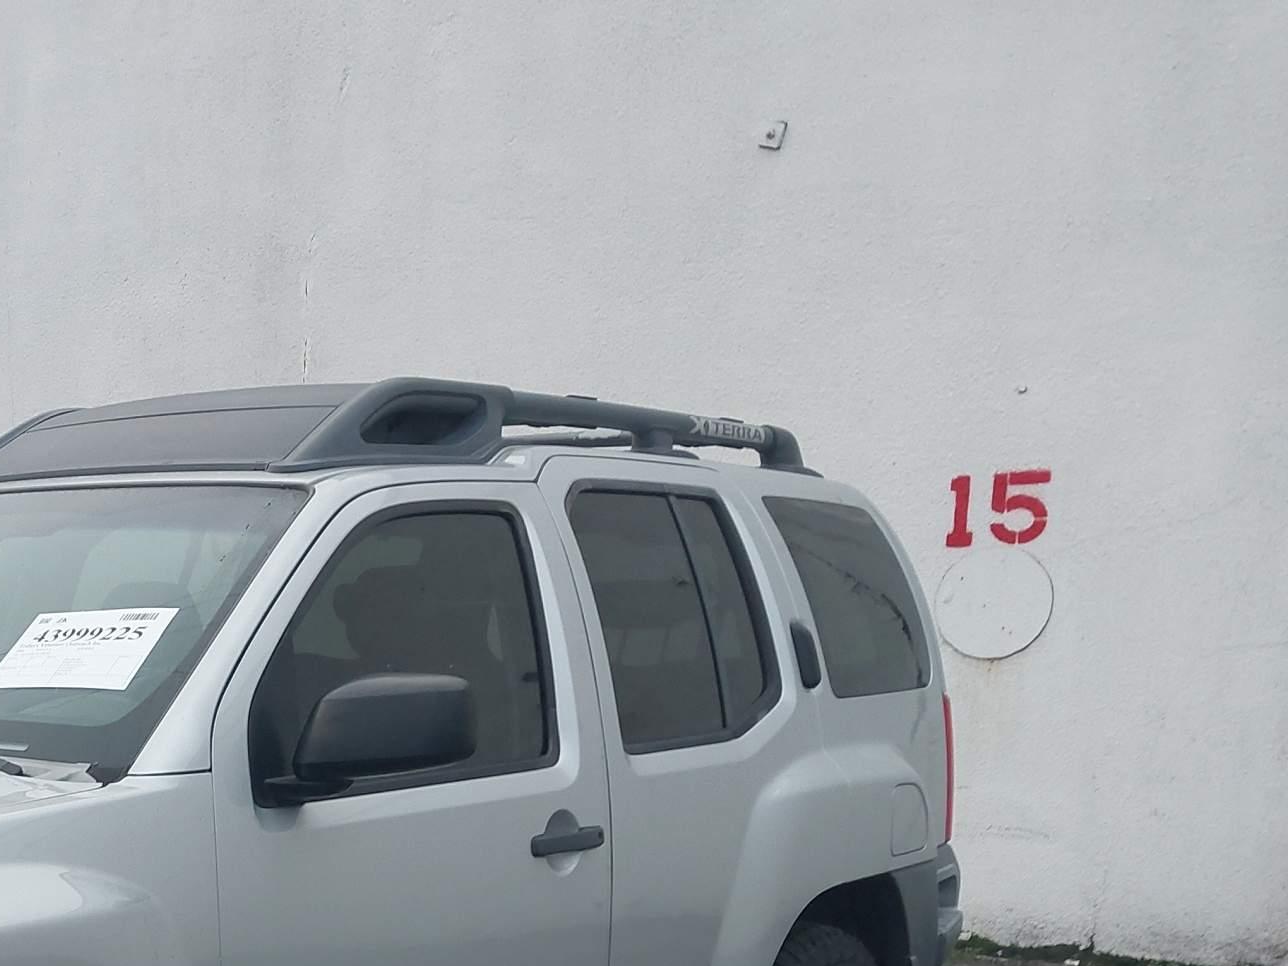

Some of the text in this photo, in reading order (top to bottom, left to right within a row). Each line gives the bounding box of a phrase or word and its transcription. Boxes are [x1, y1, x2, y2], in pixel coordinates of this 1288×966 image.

[689, 415, 765, 443] XTERRA
[944, 467, 1052, 549] 15
[33, 625, 148, 643] 43999225
